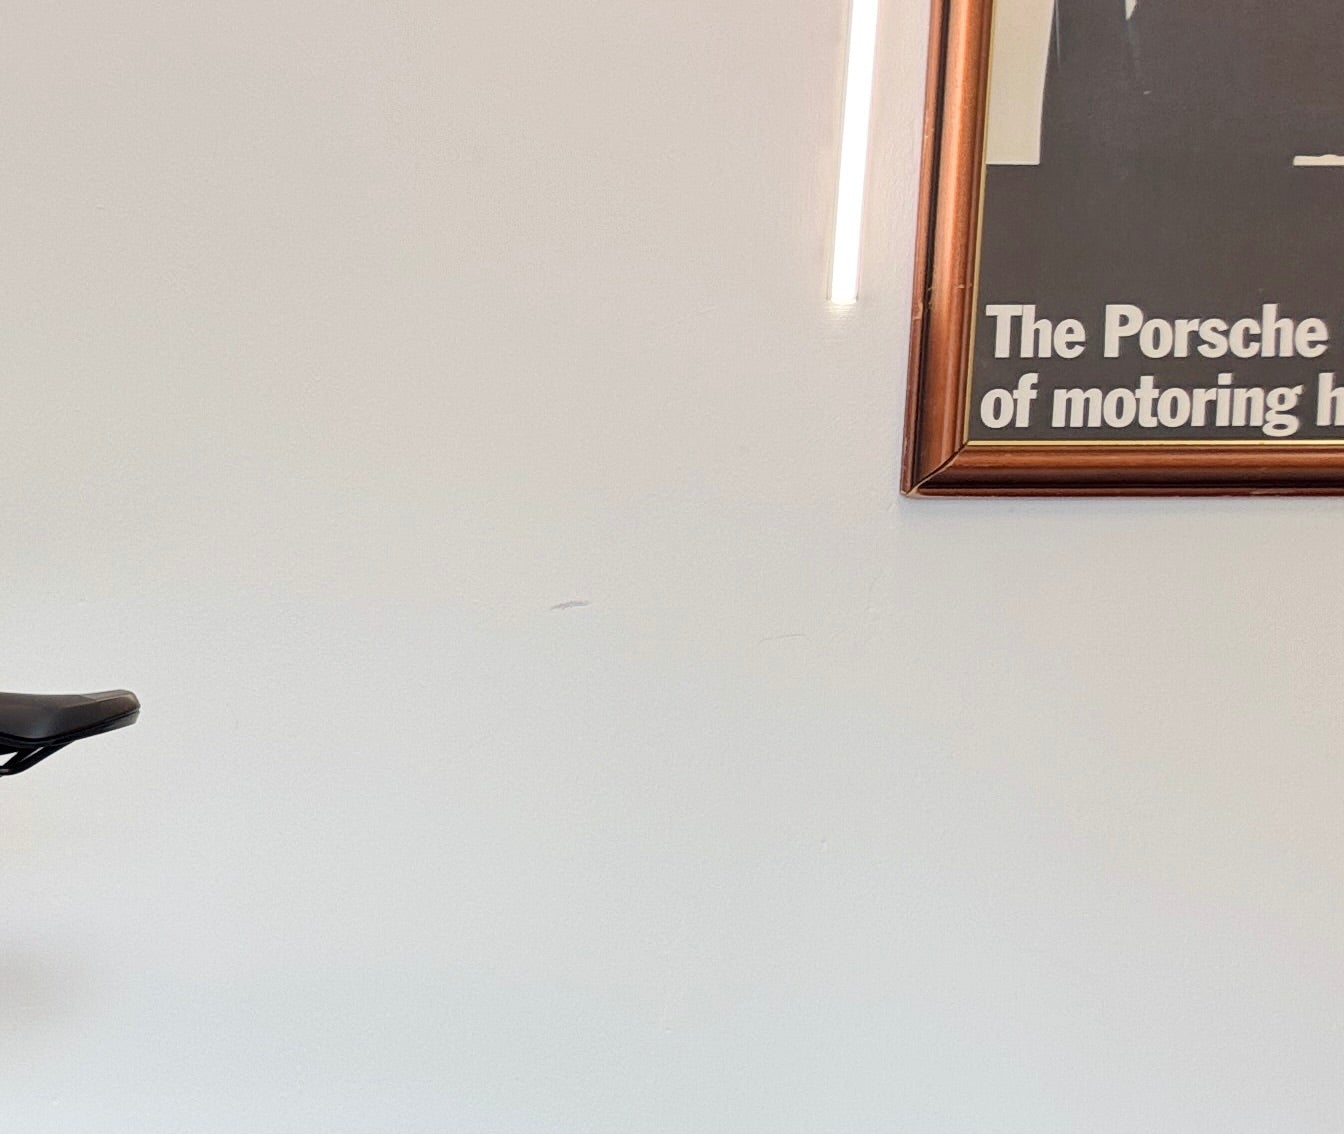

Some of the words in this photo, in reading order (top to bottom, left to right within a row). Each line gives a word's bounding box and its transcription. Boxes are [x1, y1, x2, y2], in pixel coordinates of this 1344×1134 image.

[985, 304, 1086, 359] The
[1103, 303, 1329, 359] Porsche
[980, 373, 1039, 429] of
[1051, 373, 1304, 437] motoring
